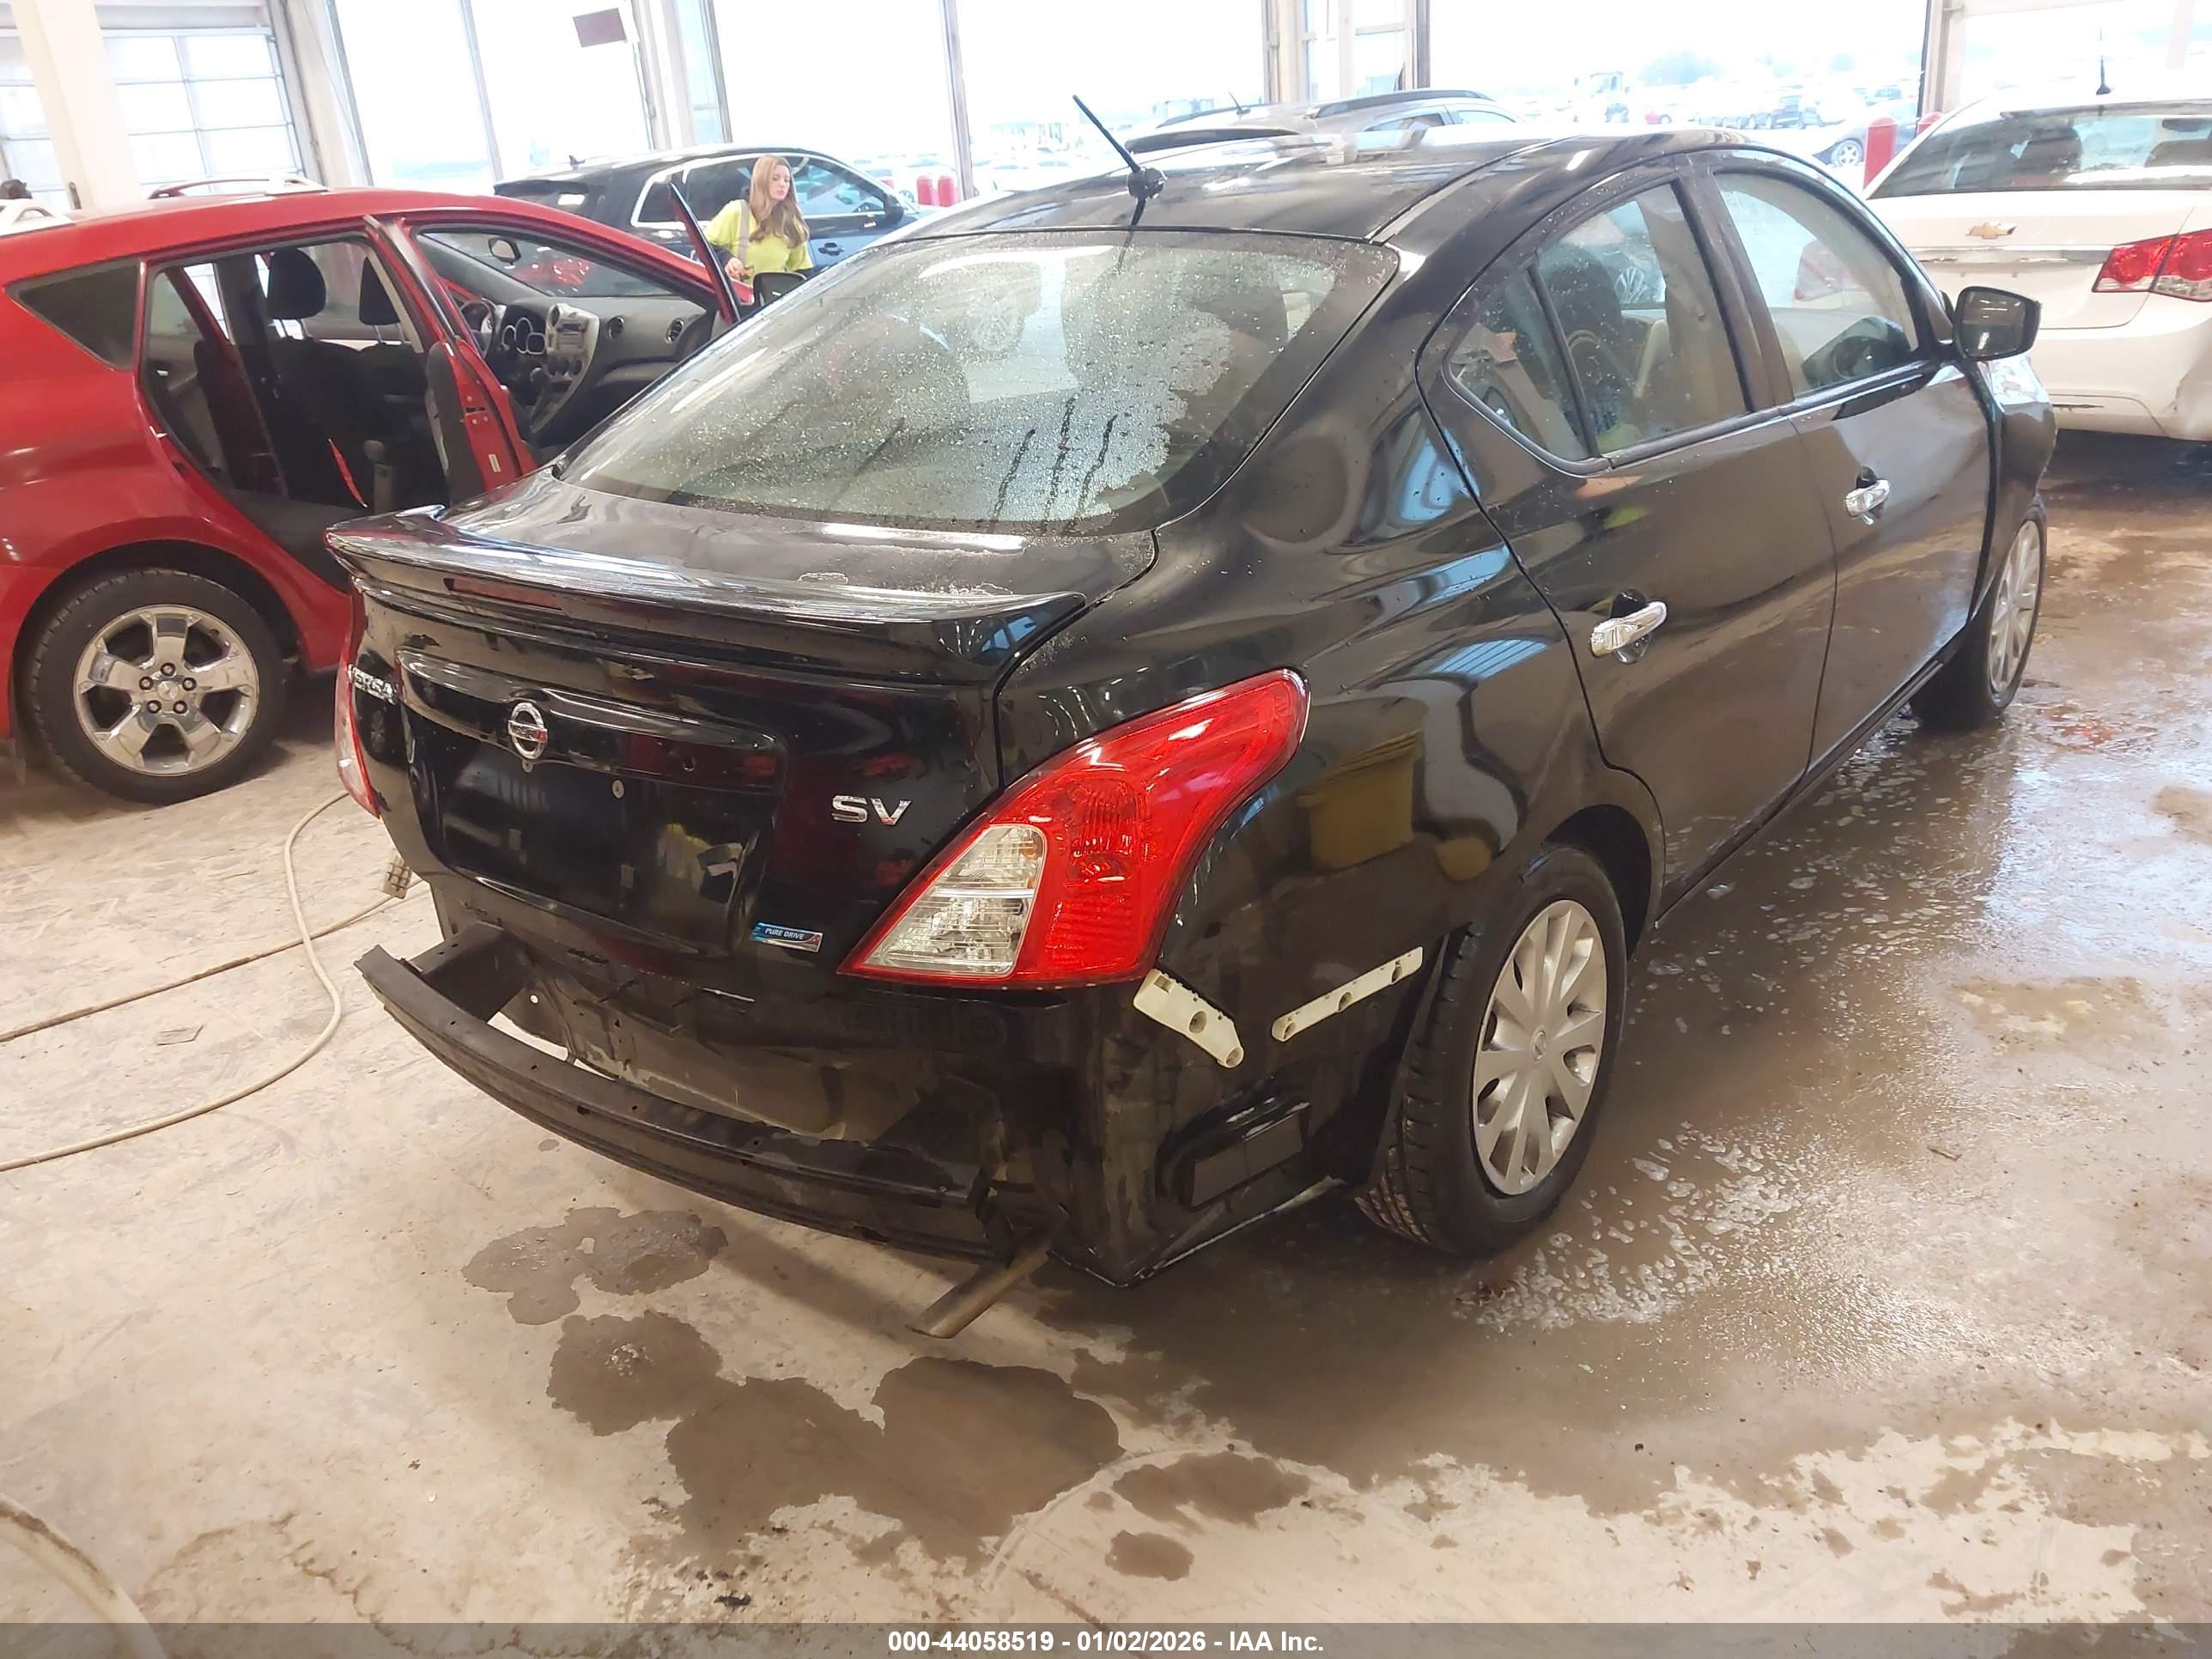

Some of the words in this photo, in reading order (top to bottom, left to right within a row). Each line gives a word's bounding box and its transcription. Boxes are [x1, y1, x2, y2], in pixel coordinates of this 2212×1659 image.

[831, 795, 912, 825] SV
[764, 927, 784, 937] PURE
[783, 931, 805, 940] DRIVE
